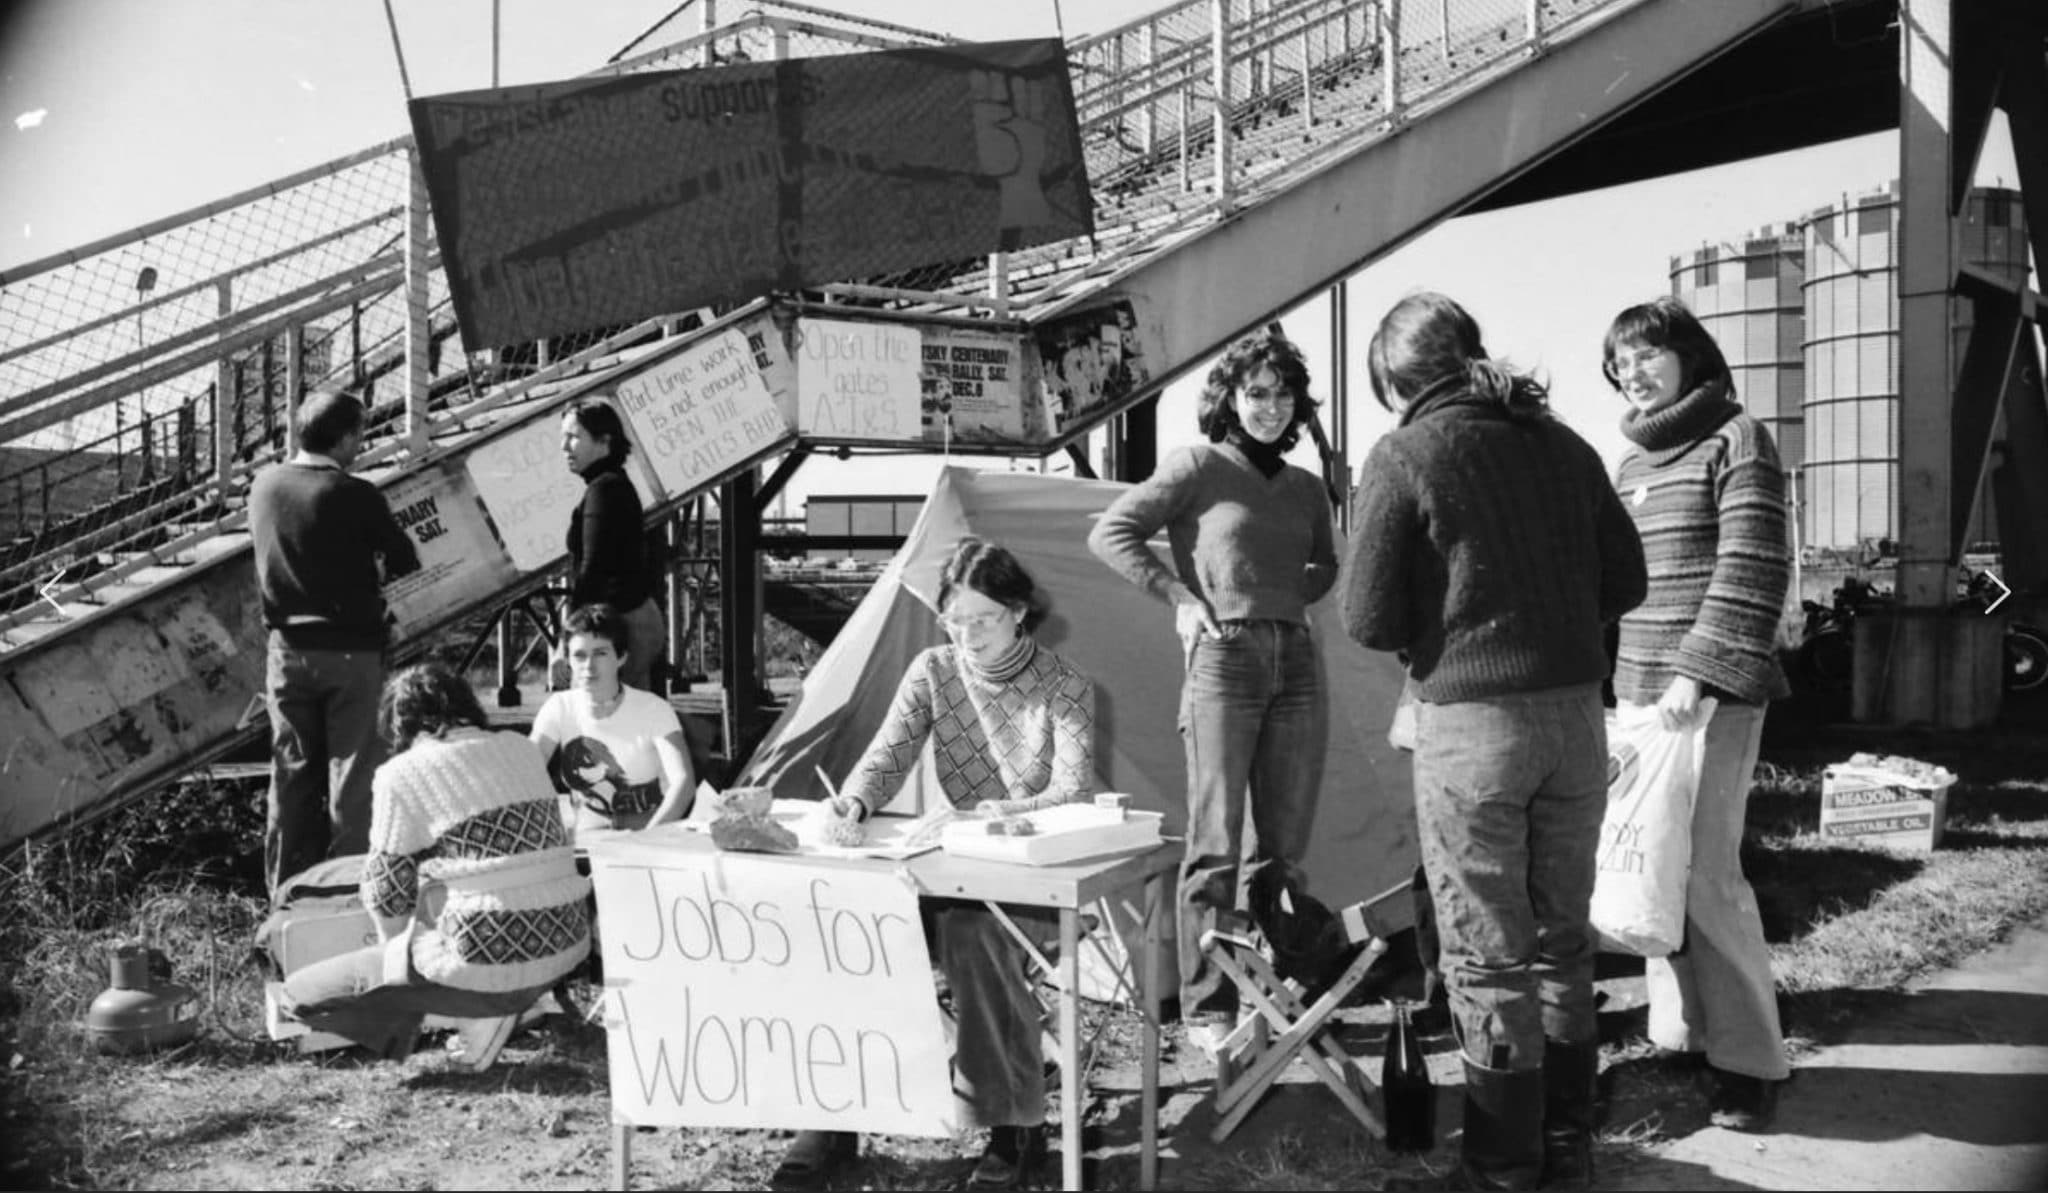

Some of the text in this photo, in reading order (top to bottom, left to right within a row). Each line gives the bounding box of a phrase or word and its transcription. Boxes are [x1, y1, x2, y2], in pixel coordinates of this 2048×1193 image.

[655, 366, 694, 395] time
[700, 335, 742, 373] work
[805, 321, 866, 378] Open
[951, 346, 1010, 364] CENTENARY
[833, 367, 889, 405] gates
[646, 411, 668, 433] is
[671, 389, 698, 417] not
[654, 415, 705, 457] OPEN
[680, 430, 738, 478] GATES
[414, 517, 449, 544] SAT.
[1903, 817, 1926, 829] OIL
[606, 863, 910, 978] Jobs for
[617, 985, 913, 1114] Women
